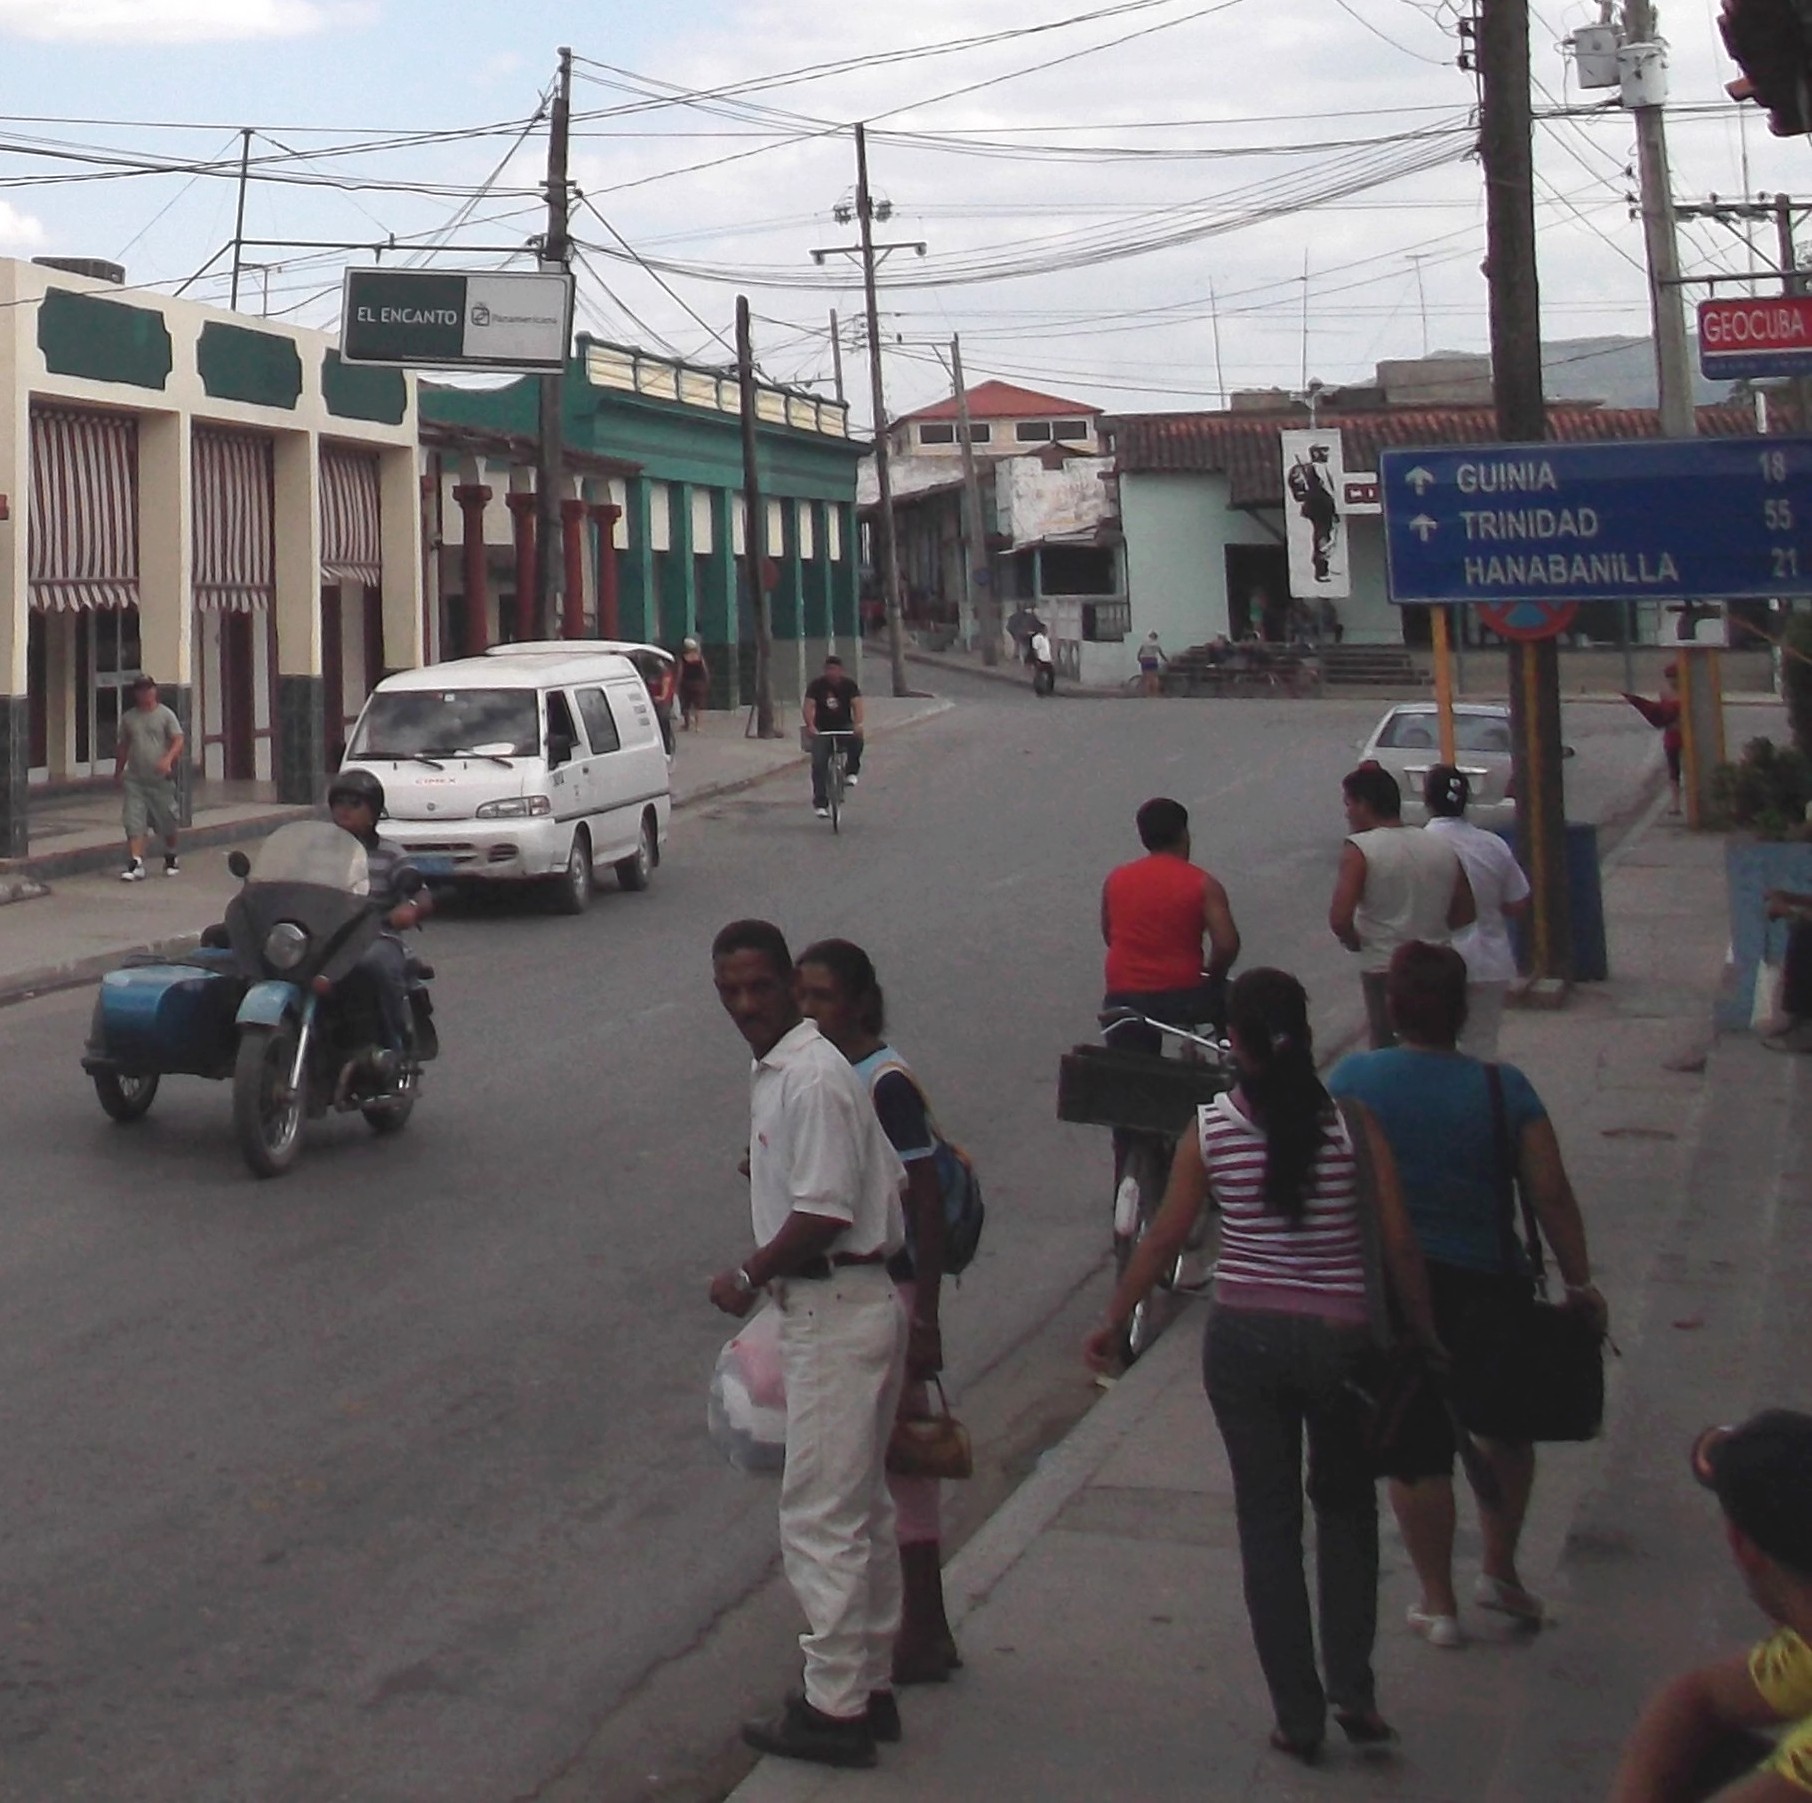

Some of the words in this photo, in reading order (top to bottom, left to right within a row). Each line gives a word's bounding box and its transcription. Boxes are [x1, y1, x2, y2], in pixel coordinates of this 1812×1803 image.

[357, 306, 376, 322] EL
[380, 307, 457, 326] ENCANTO
[1703, 309, 1805, 342] GEOCUBA
[1456, 461, 1557, 493] GUINIA
[1758, 451, 1786, 482] 18
[1459, 507, 1598, 540] TRINIDAD
[1764, 499, 1792, 530] 55
[1464, 552, 1679, 585] HANABANILLA
[1771, 547, 1798, 578] 21
